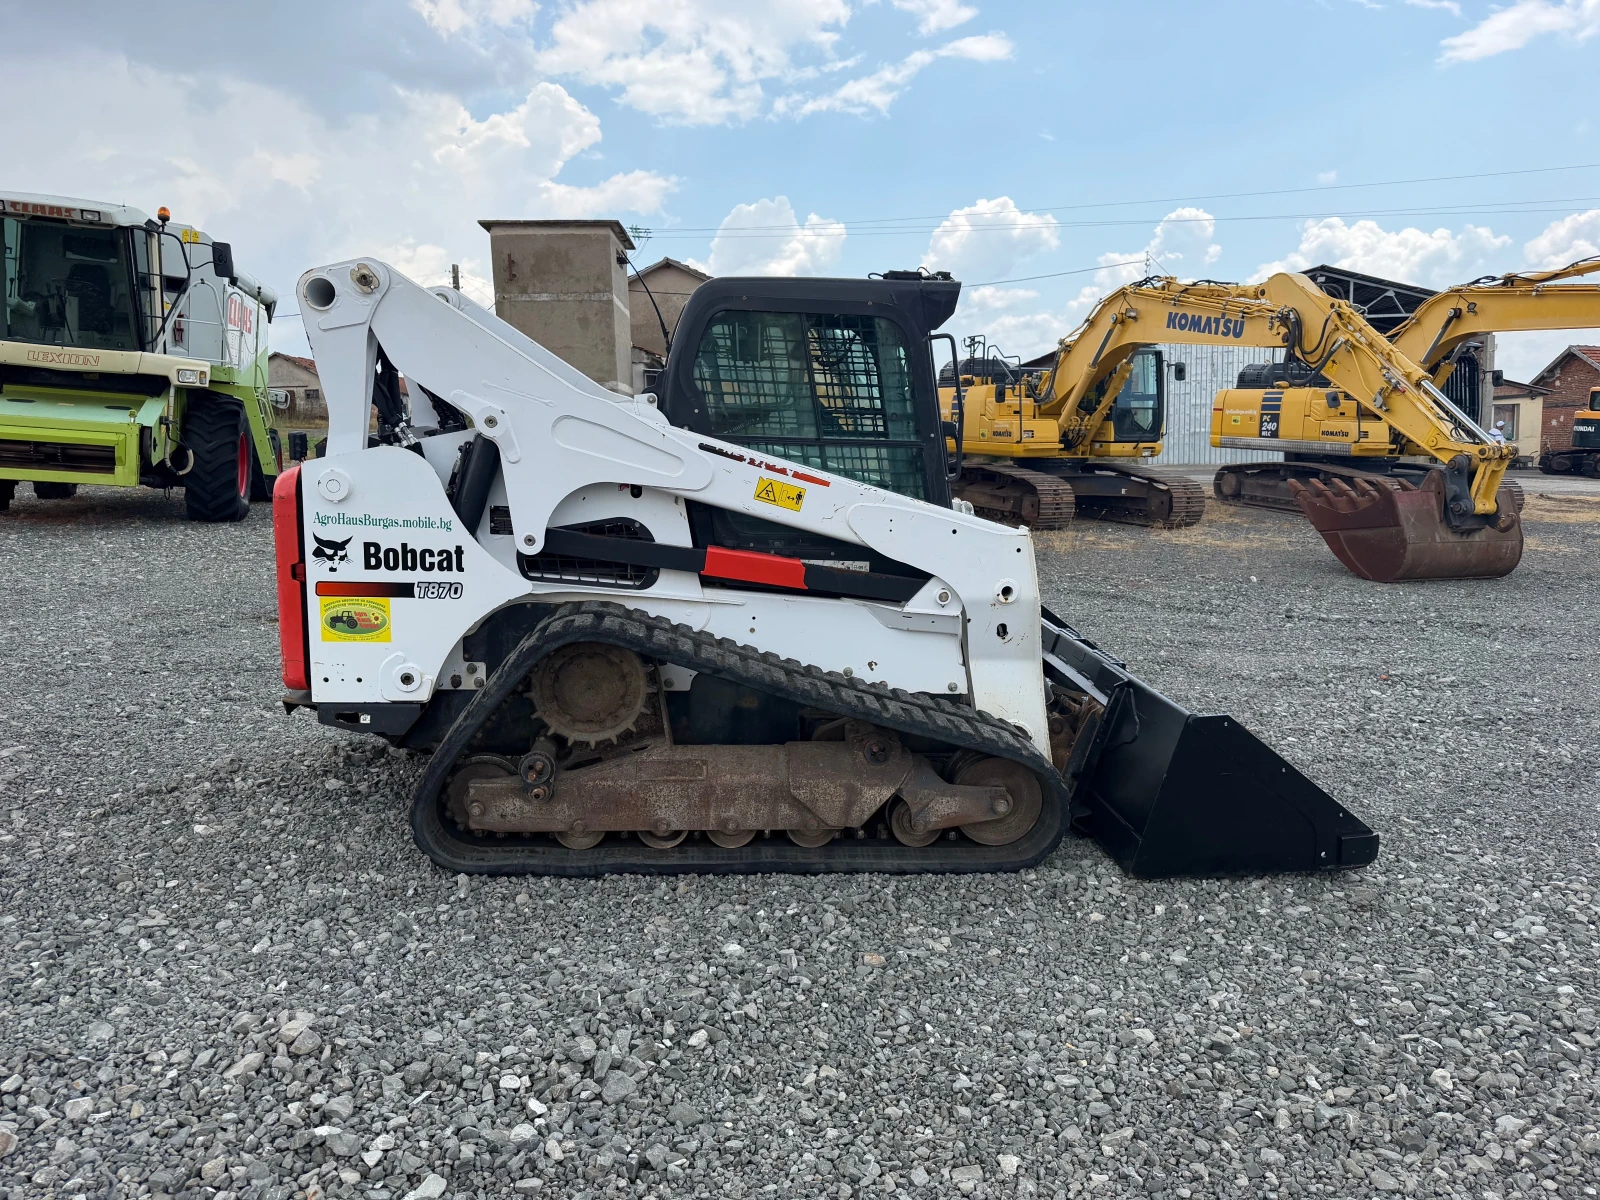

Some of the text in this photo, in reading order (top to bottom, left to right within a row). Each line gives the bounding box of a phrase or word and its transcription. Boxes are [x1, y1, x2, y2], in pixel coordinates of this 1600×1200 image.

[10, 201, 76, 218] CLAAS
[1166, 312, 1246, 339] KOMATSU
[27, 350, 100, 366] LEXION
[1261, 422, 1277, 431] 240
[313, 511, 453, 532] AgroHausBurgas.mobile.bg
[363, 541, 465, 573] Bobcat
[416, 581, 464, 599] T870
